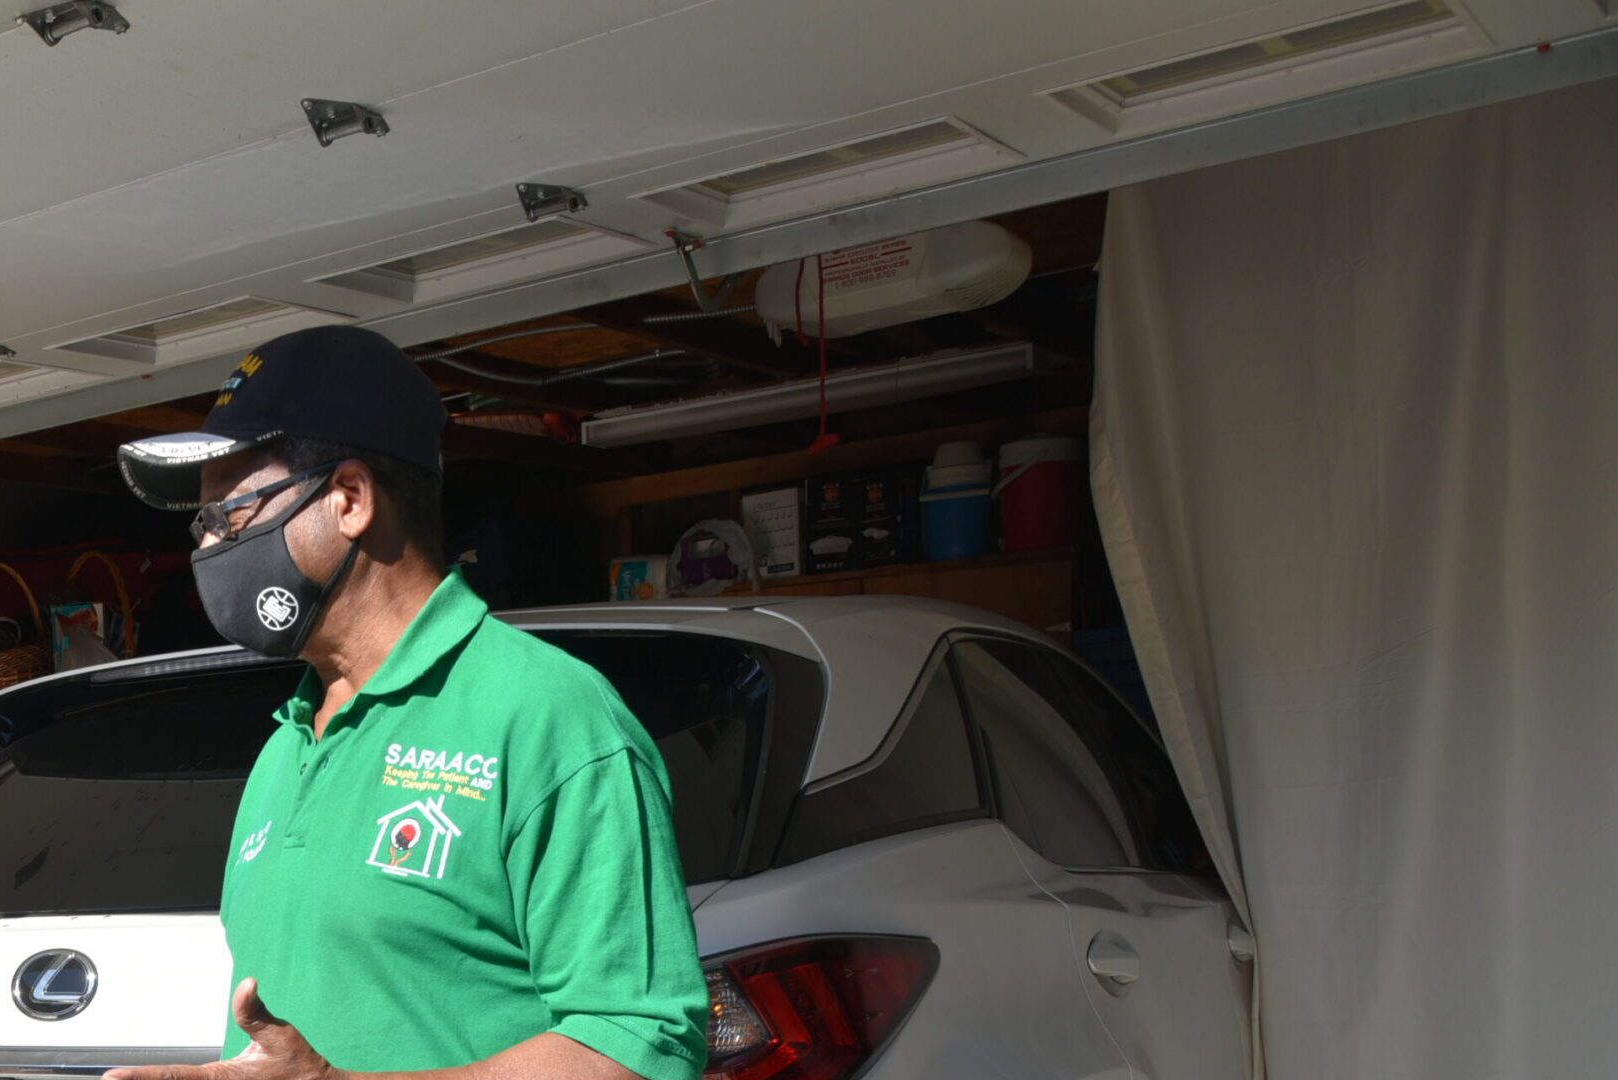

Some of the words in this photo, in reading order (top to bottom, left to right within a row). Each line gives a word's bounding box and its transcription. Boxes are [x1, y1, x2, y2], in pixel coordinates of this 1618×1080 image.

[385, 744, 498, 778] SARAACC
[381, 776, 398, 787] The
[401, 779, 441, 792] Caregiver
[384, 766, 419, 781] Keeping
[437, 771, 470, 784] Patient
[469, 776, 493, 791] AND
